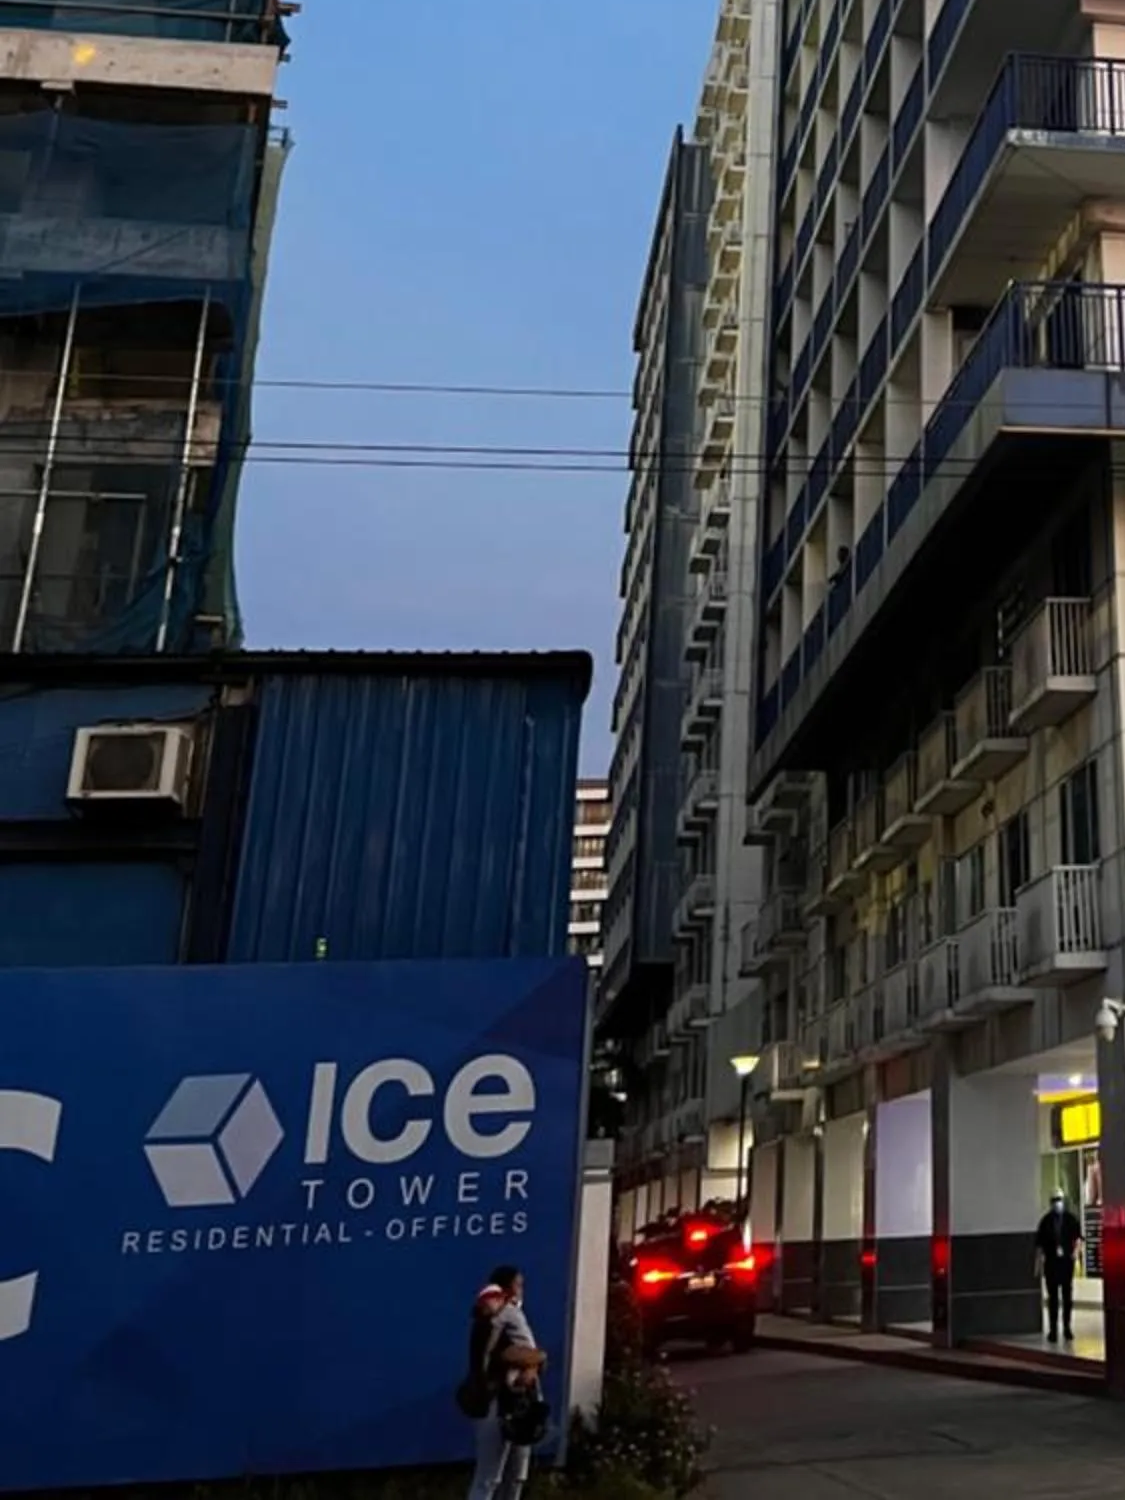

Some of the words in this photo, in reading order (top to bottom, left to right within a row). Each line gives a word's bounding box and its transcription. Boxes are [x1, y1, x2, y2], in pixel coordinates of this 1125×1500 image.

[302, 1170, 529, 1209] TOWER
[122, 1222, 352, 1254] RESIDENTIAL
[385, 1211, 529, 1241] OFFICES
